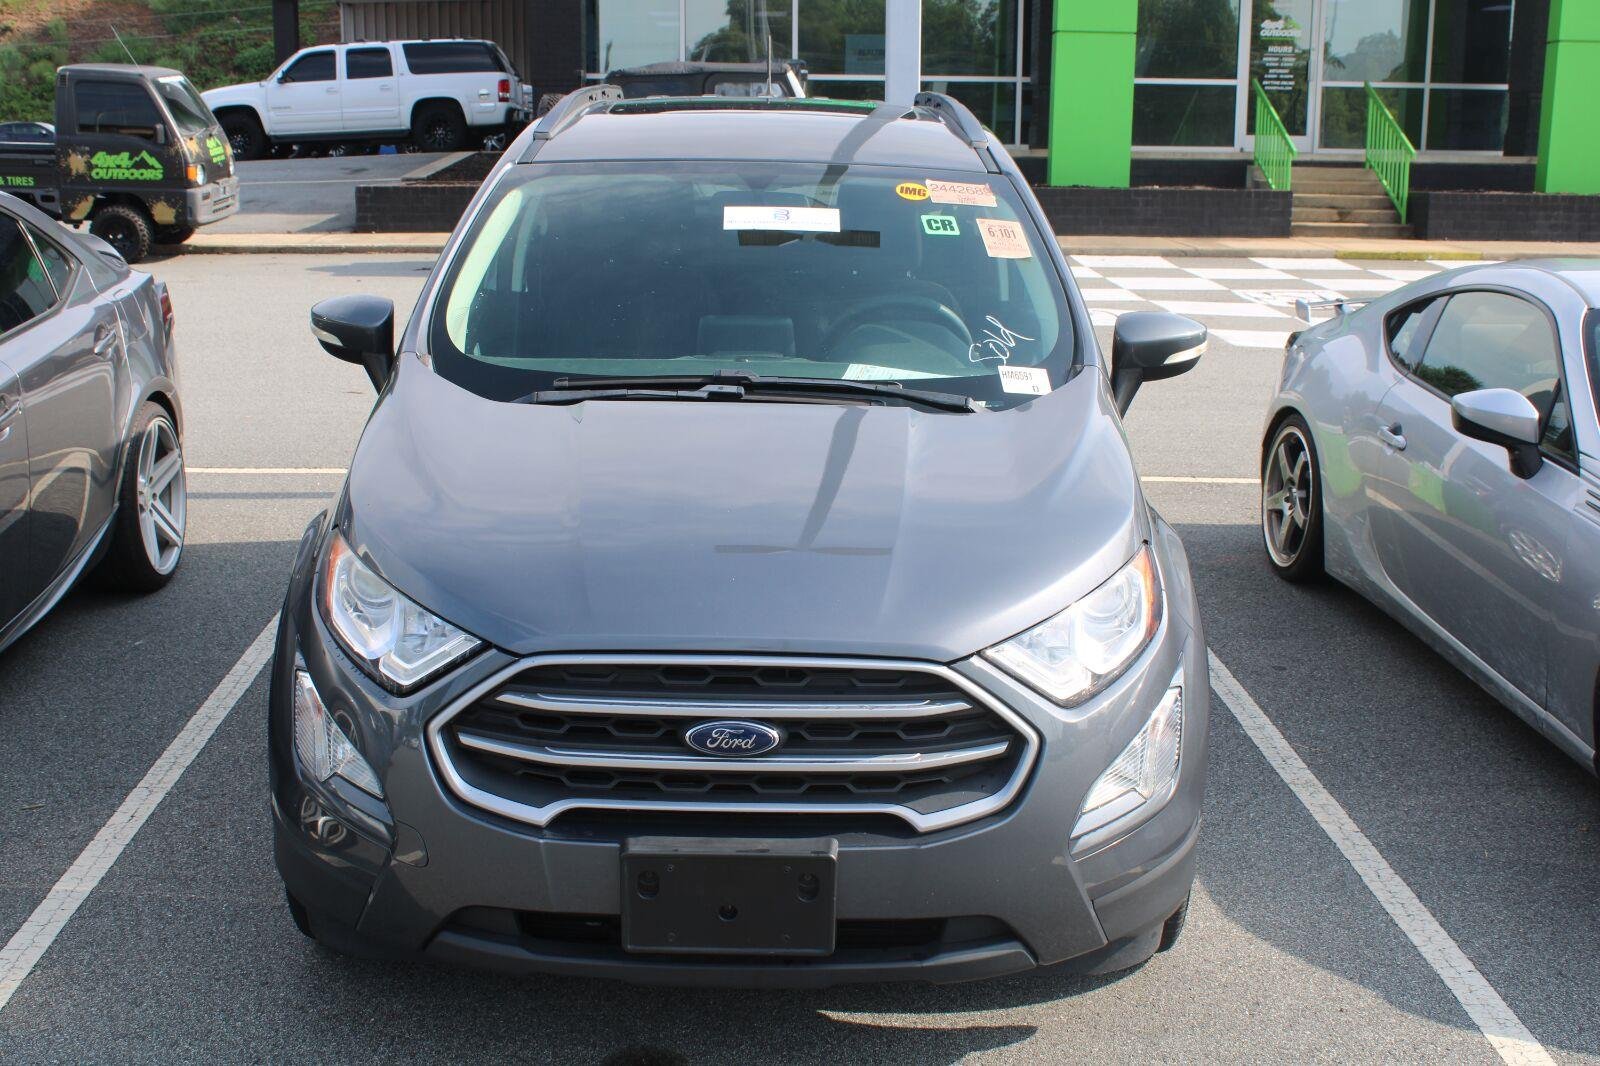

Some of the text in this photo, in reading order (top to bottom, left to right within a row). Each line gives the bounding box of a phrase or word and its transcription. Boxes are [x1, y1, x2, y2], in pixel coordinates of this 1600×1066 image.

[90, 151, 131, 168] 4x4
[91, 168, 164, 180] OUTDOORS
[6, 176, 35, 186] TIRES
[926, 218, 955, 231] CR
[706, 728, 757, 749] Ford
